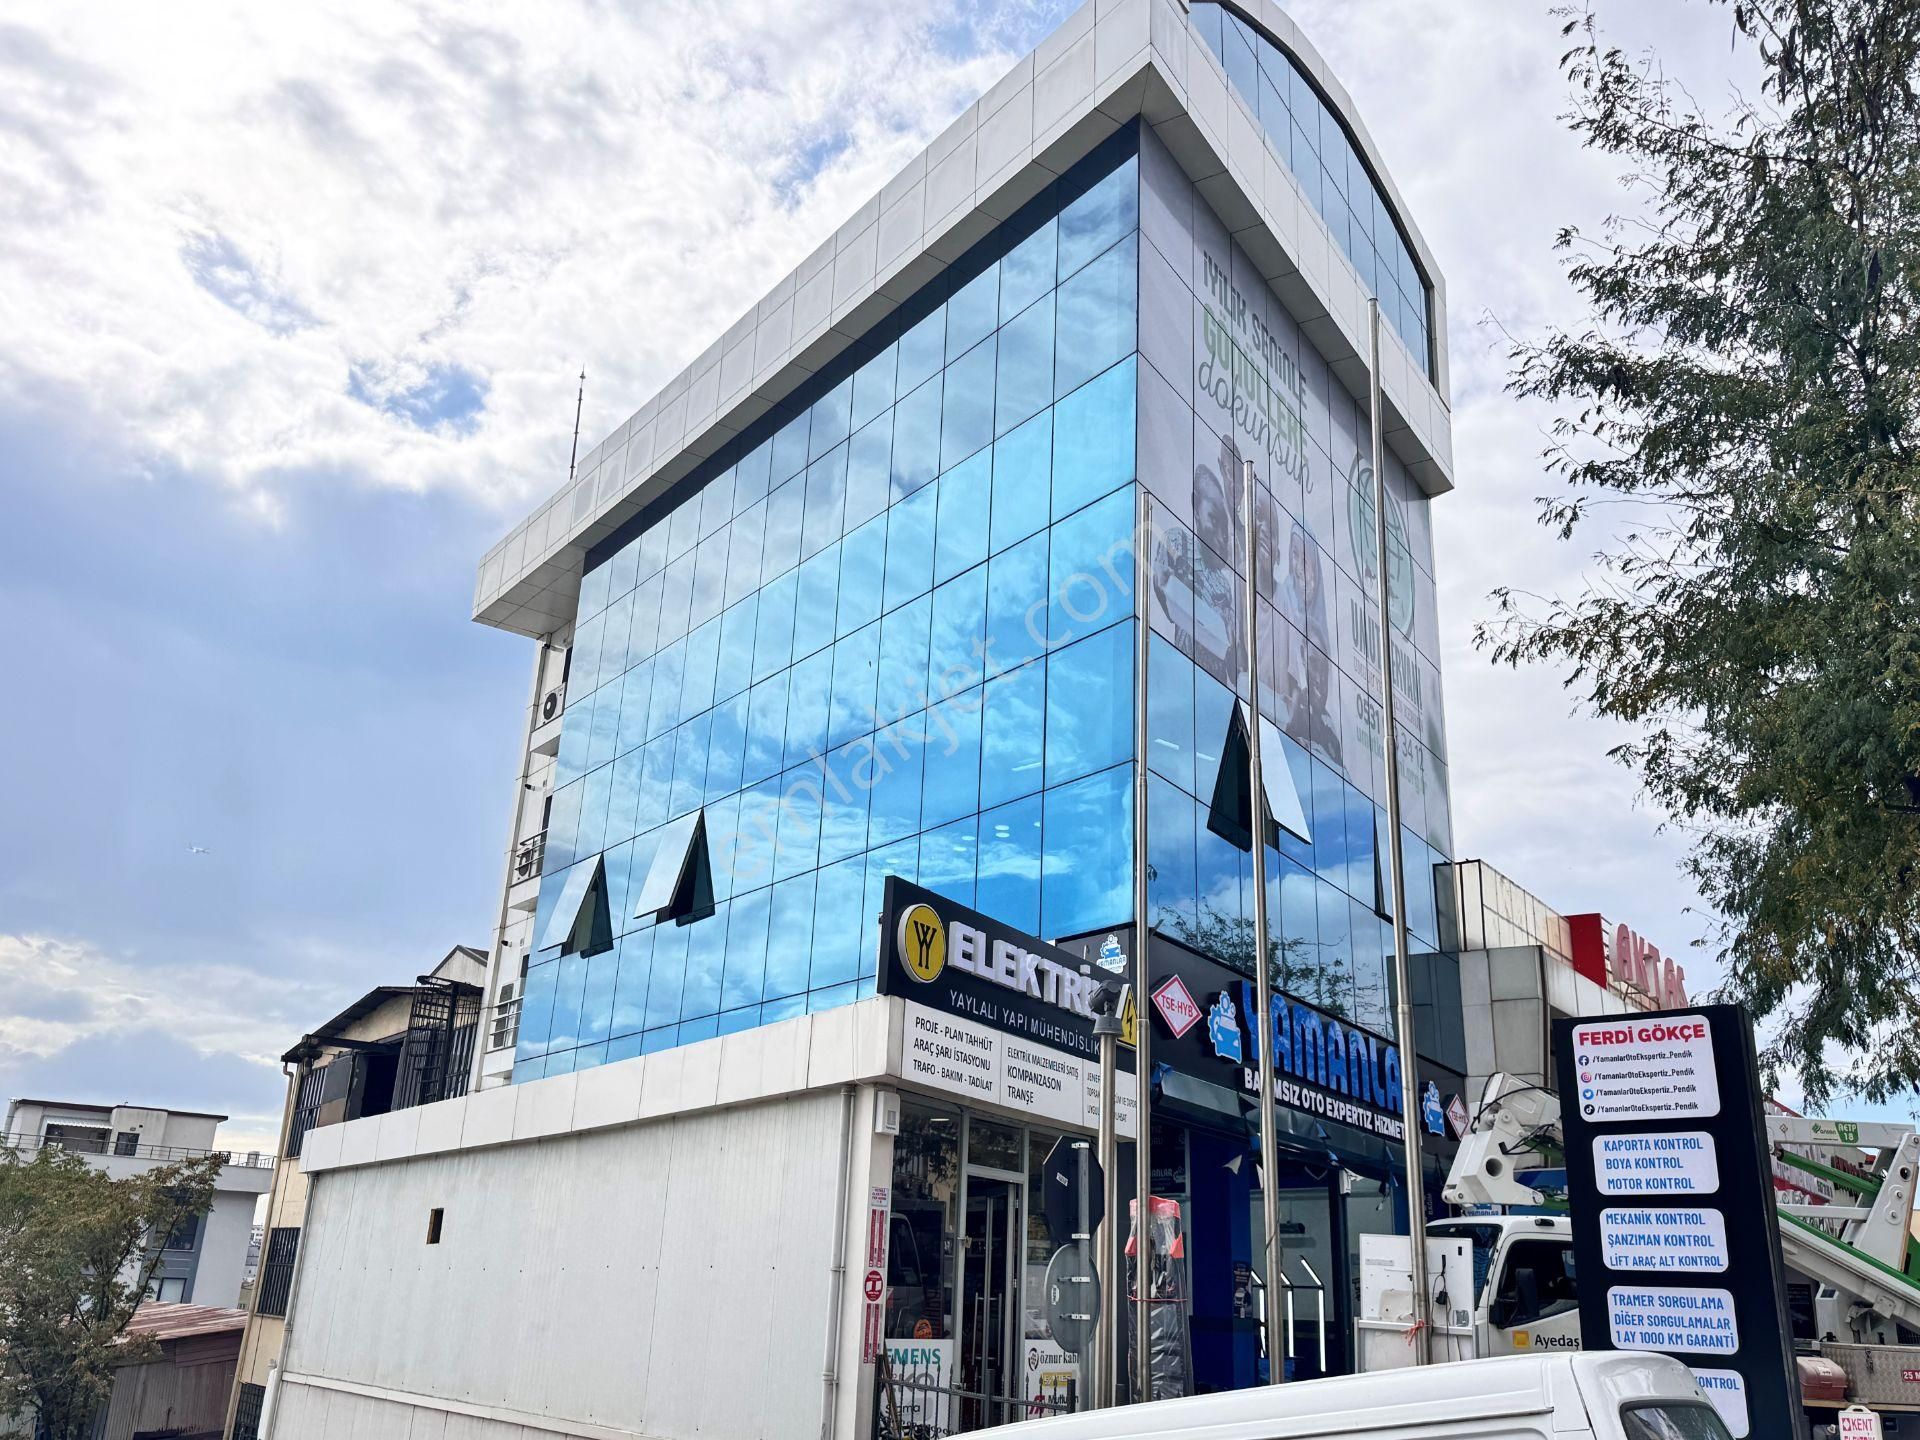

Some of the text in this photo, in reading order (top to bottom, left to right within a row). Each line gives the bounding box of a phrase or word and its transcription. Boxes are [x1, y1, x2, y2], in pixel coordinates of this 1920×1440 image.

[1390, 639, 1423, 714] ERVANI
[1161, 994, 1193, 1018] TSE-HYB
[950, 989, 1101, 1056] YAYLALI YAPI MÜHENDİSLİK
[915, 1016, 939, 1035] PROJE
[945, 1026, 963, 1042] PLAN
[965, 1032, 993, 1051] TAHHÜT
[1579, 1024, 1706, 1046] FERDİ GÖKÇE
[913, 1037, 935, 1056] ARAÇ
[953, 1047, 991, 1071] İSTASYONU
[1242, 979, 1404, 1115] YAMANLA
[1007, 1046, 1032, 1064] ELEKTRİK
[1031, 1054, 1066, 1074] MALZEMELERİ
[913, 1059, 936, 1075] TRAFO
[941, 1067, 963, 1083] BAKIM
[968, 1075, 993, 1091] TADİLAT
[1007, 1065, 1061, 1091] KOMPANZASON
[1007, 1085, 1034, 1105] TRANŞE
[1244, 1067, 1300, 1106] BAMSIZ
[1301, 1087, 1325, 1114] OTO
[1604, 1138, 1704, 1152] KAPORTA KONTROL
[1605, 1157, 1684, 1170] BOYA KONTROL
[1607, 1177, 1696, 1190] MOTOR KONTROL
[1605, 1210, 1706, 1225] MEKANİK KONTROL
[1607, 1233, 1715, 1248] ŞANZIMAN KONTROL
[1610, 1252, 1724, 1269] LİFT ARAÇ ALT KONTROL
[1612, 1293, 1724, 1310] TRAMER SORGULAMA
[1614, 1310, 1731, 1330] DİĞER SORGULAMALAR
[1534, 1334, 1580, 1351] Ayedaş
[1615, 1330, 1735, 1348] 1 AY 1000 KM GARANTİ
[886, 1348, 941, 1365] EMENS
[1695, 1376, 1740, 1390] ONTROL
[1903, 1371, 1913, 1380] 25
[1851, 1418, 1873, 1432] KENT
